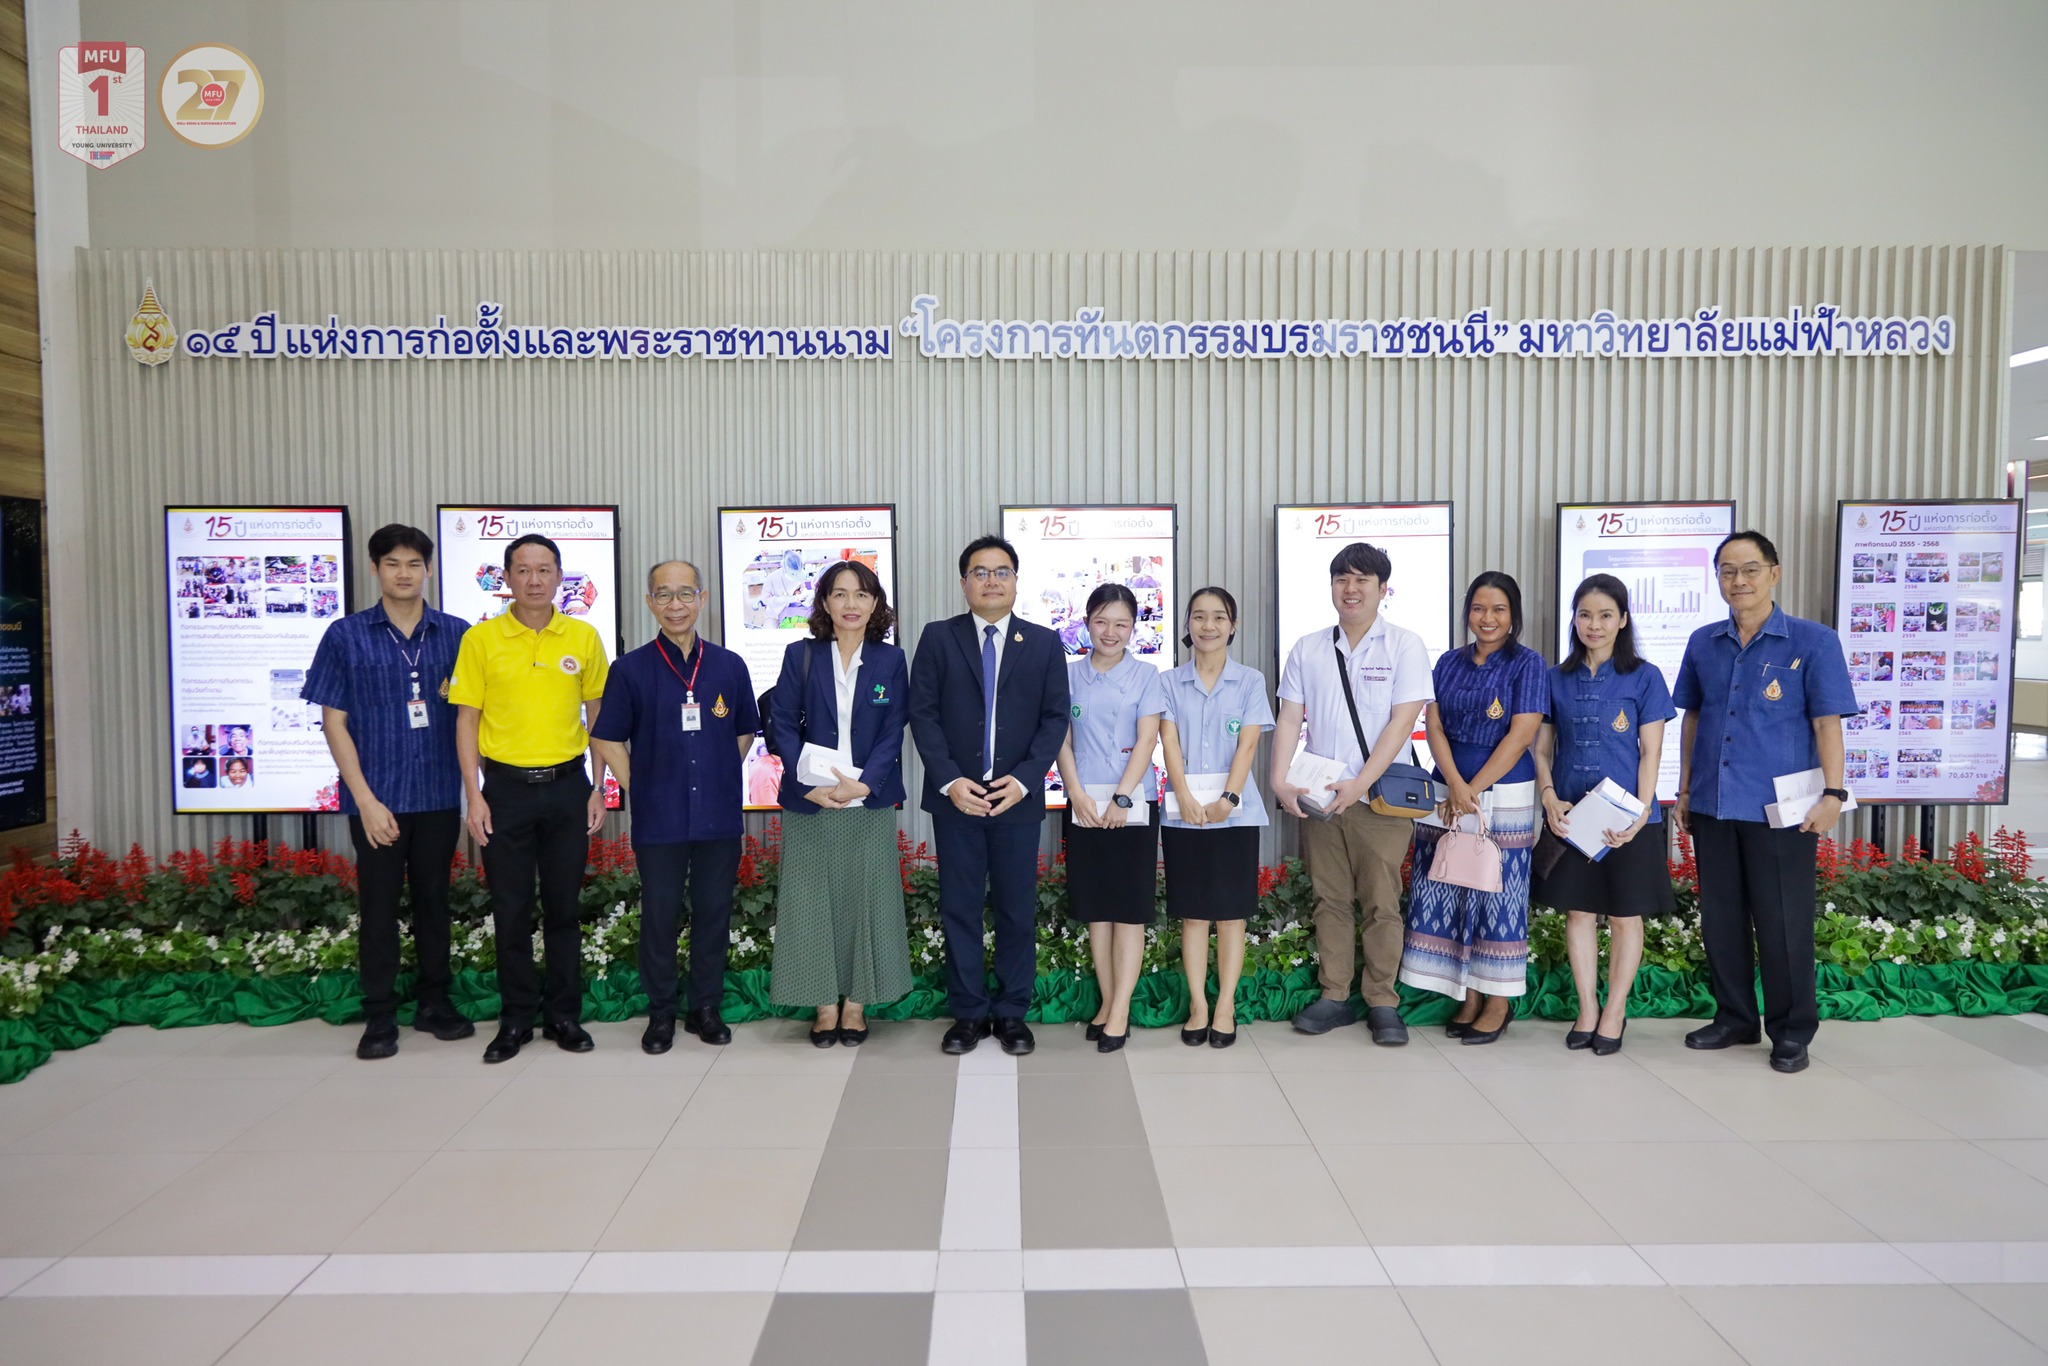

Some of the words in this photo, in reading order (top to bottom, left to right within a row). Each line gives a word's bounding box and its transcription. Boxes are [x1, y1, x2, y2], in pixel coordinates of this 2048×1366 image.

[186, 325, 241, 355] ๑๕
[250, 303, 276, 354] ปี
[1518, 304, 1950, 354] มหาวิทยาลัยแม่ฟ้าหลวง
[205, 516, 233, 538] 15
[234, 520, 247, 538] ปี
[250, 517, 322, 530] แห่งการก่อตั้ง
[477, 515, 505, 537] 15
[506, 519, 519, 537] ปี
[522, 516, 593, 529] แห่งการก่อตั้ง
[757, 516, 784, 538] 15
[786, 520, 797, 538] ปี
[801, 516, 871, 529] แห่งการก่อตั้ง
[1040, 515, 1067, 537] 15
[1068, 520, 1080, 536] ปี
[1314, 514, 1342, 535] 15
[1343, 518, 1355, 535] ปี
[1597, 513, 1624, 534] 15
[1626, 517, 1637, 534] ปี
[1641, 512, 1712, 525] แห่งการก่อตั้ง
[1879, 510, 1908, 532] 15
[1908, 514, 1921, 531] ปี
[1924, 512, 1998, 523] แห่งการก่อตั้ง
